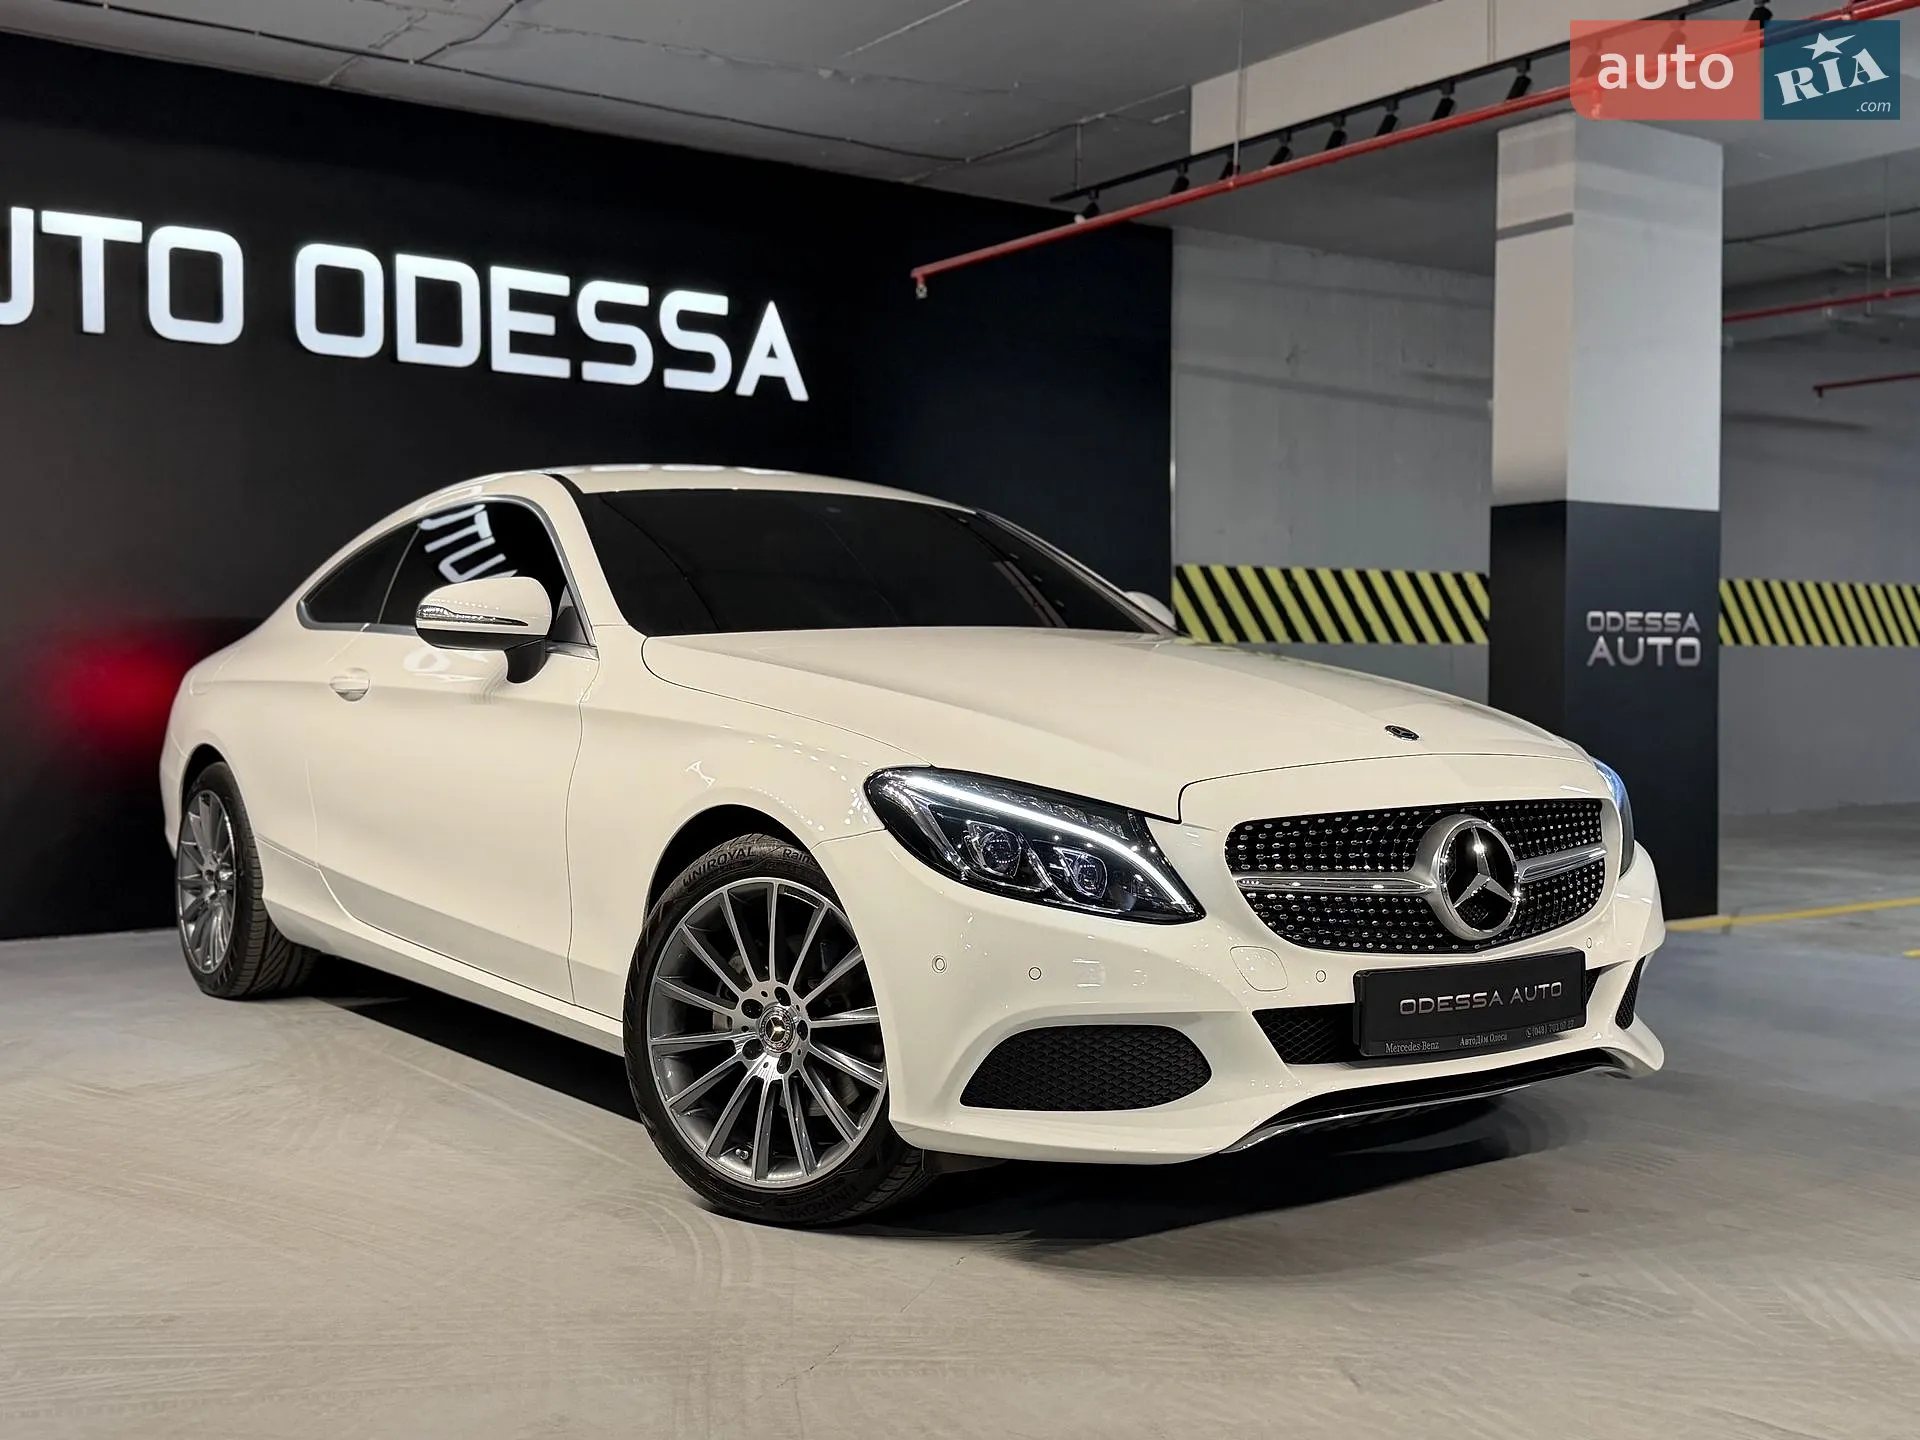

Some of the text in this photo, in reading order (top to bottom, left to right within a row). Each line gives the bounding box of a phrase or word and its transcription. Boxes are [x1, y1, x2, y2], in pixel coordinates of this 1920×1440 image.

[295, 243, 809, 402] ODESSA
[1586, 610, 1701, 633] ODESSA
[1586, 635, 1701, 667] AUTO
[682, 846, 756, 888] UNIROYAL
[1400, 981, 1562, 1016] ODESSA AUTO
